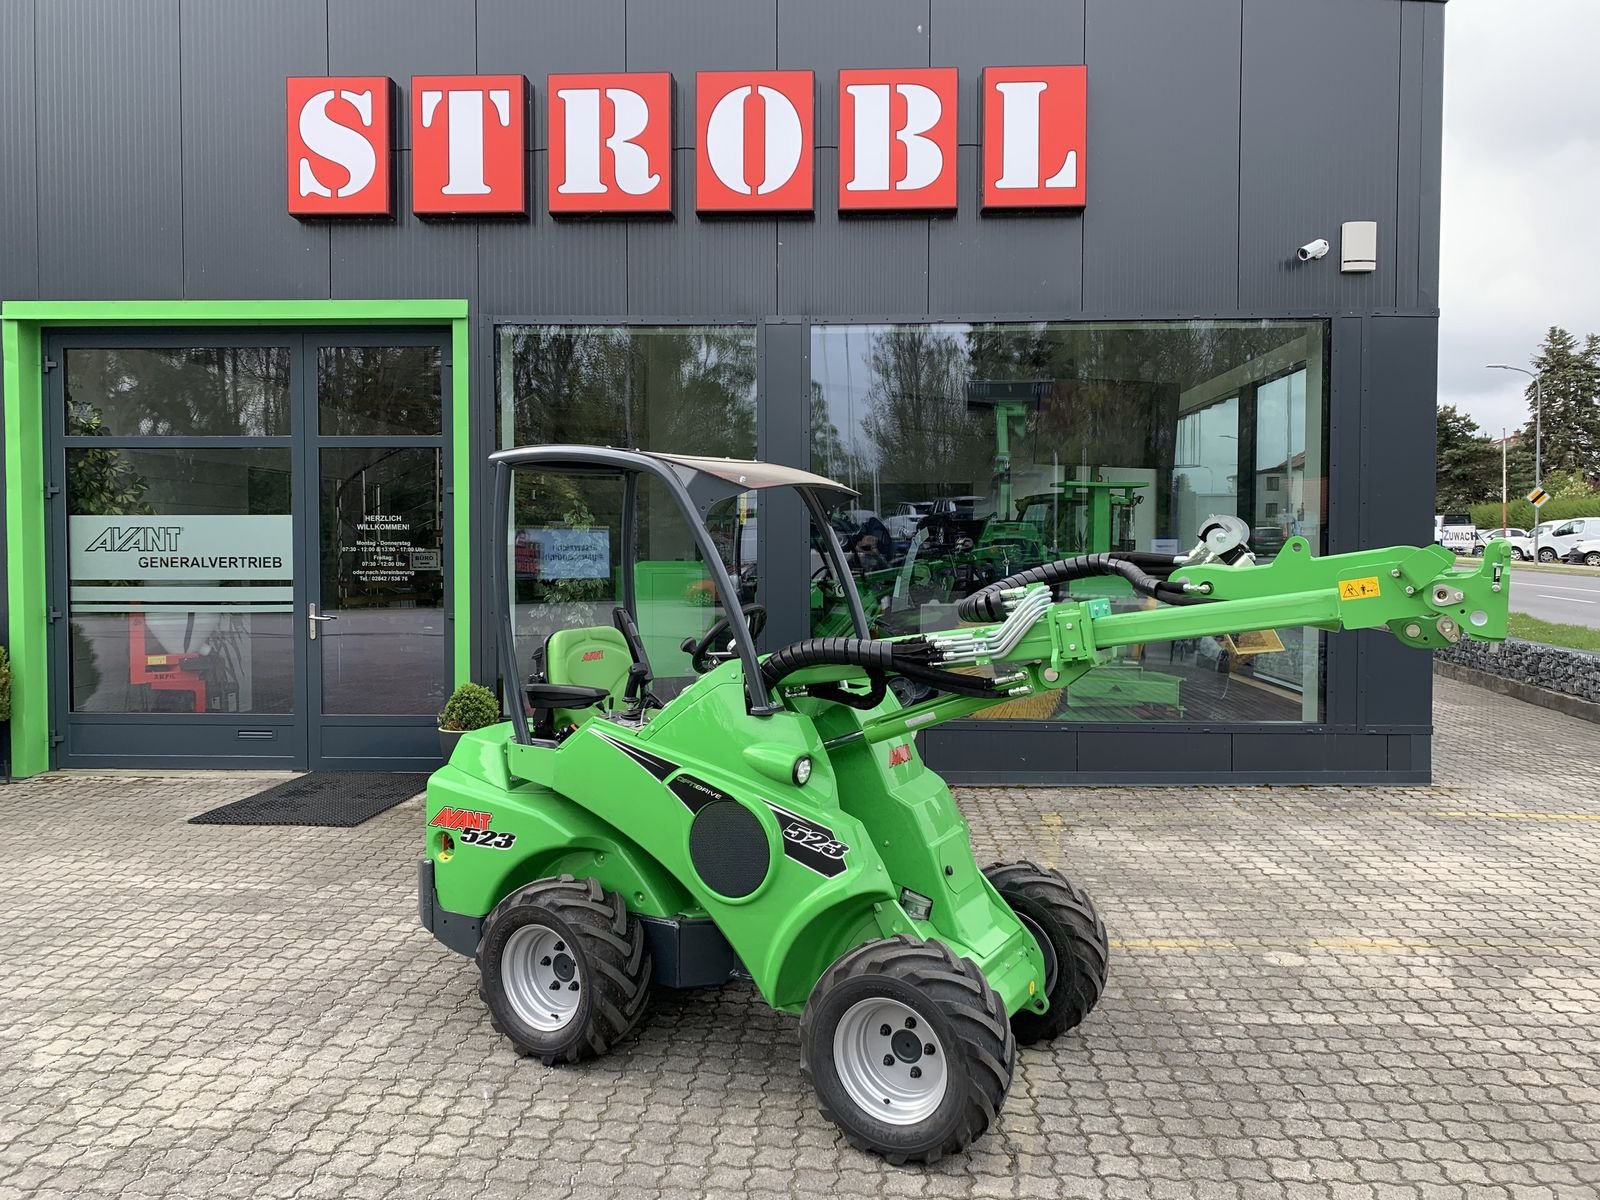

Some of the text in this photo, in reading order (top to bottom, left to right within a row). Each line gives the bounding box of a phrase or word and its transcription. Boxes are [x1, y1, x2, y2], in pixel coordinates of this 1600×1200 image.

[297, 81, 1078, 199] STROBL
[84, 526, 181, 552] AVANT
[356, 523, 410, 531] WILLKOMMEN!
[138, 556, 283, 568] GENERALVERTRIEB
[428, 806, 493, 832] AVANT
[460, 826, 517, 851] 523
[782, 821, 851, 859] 523
